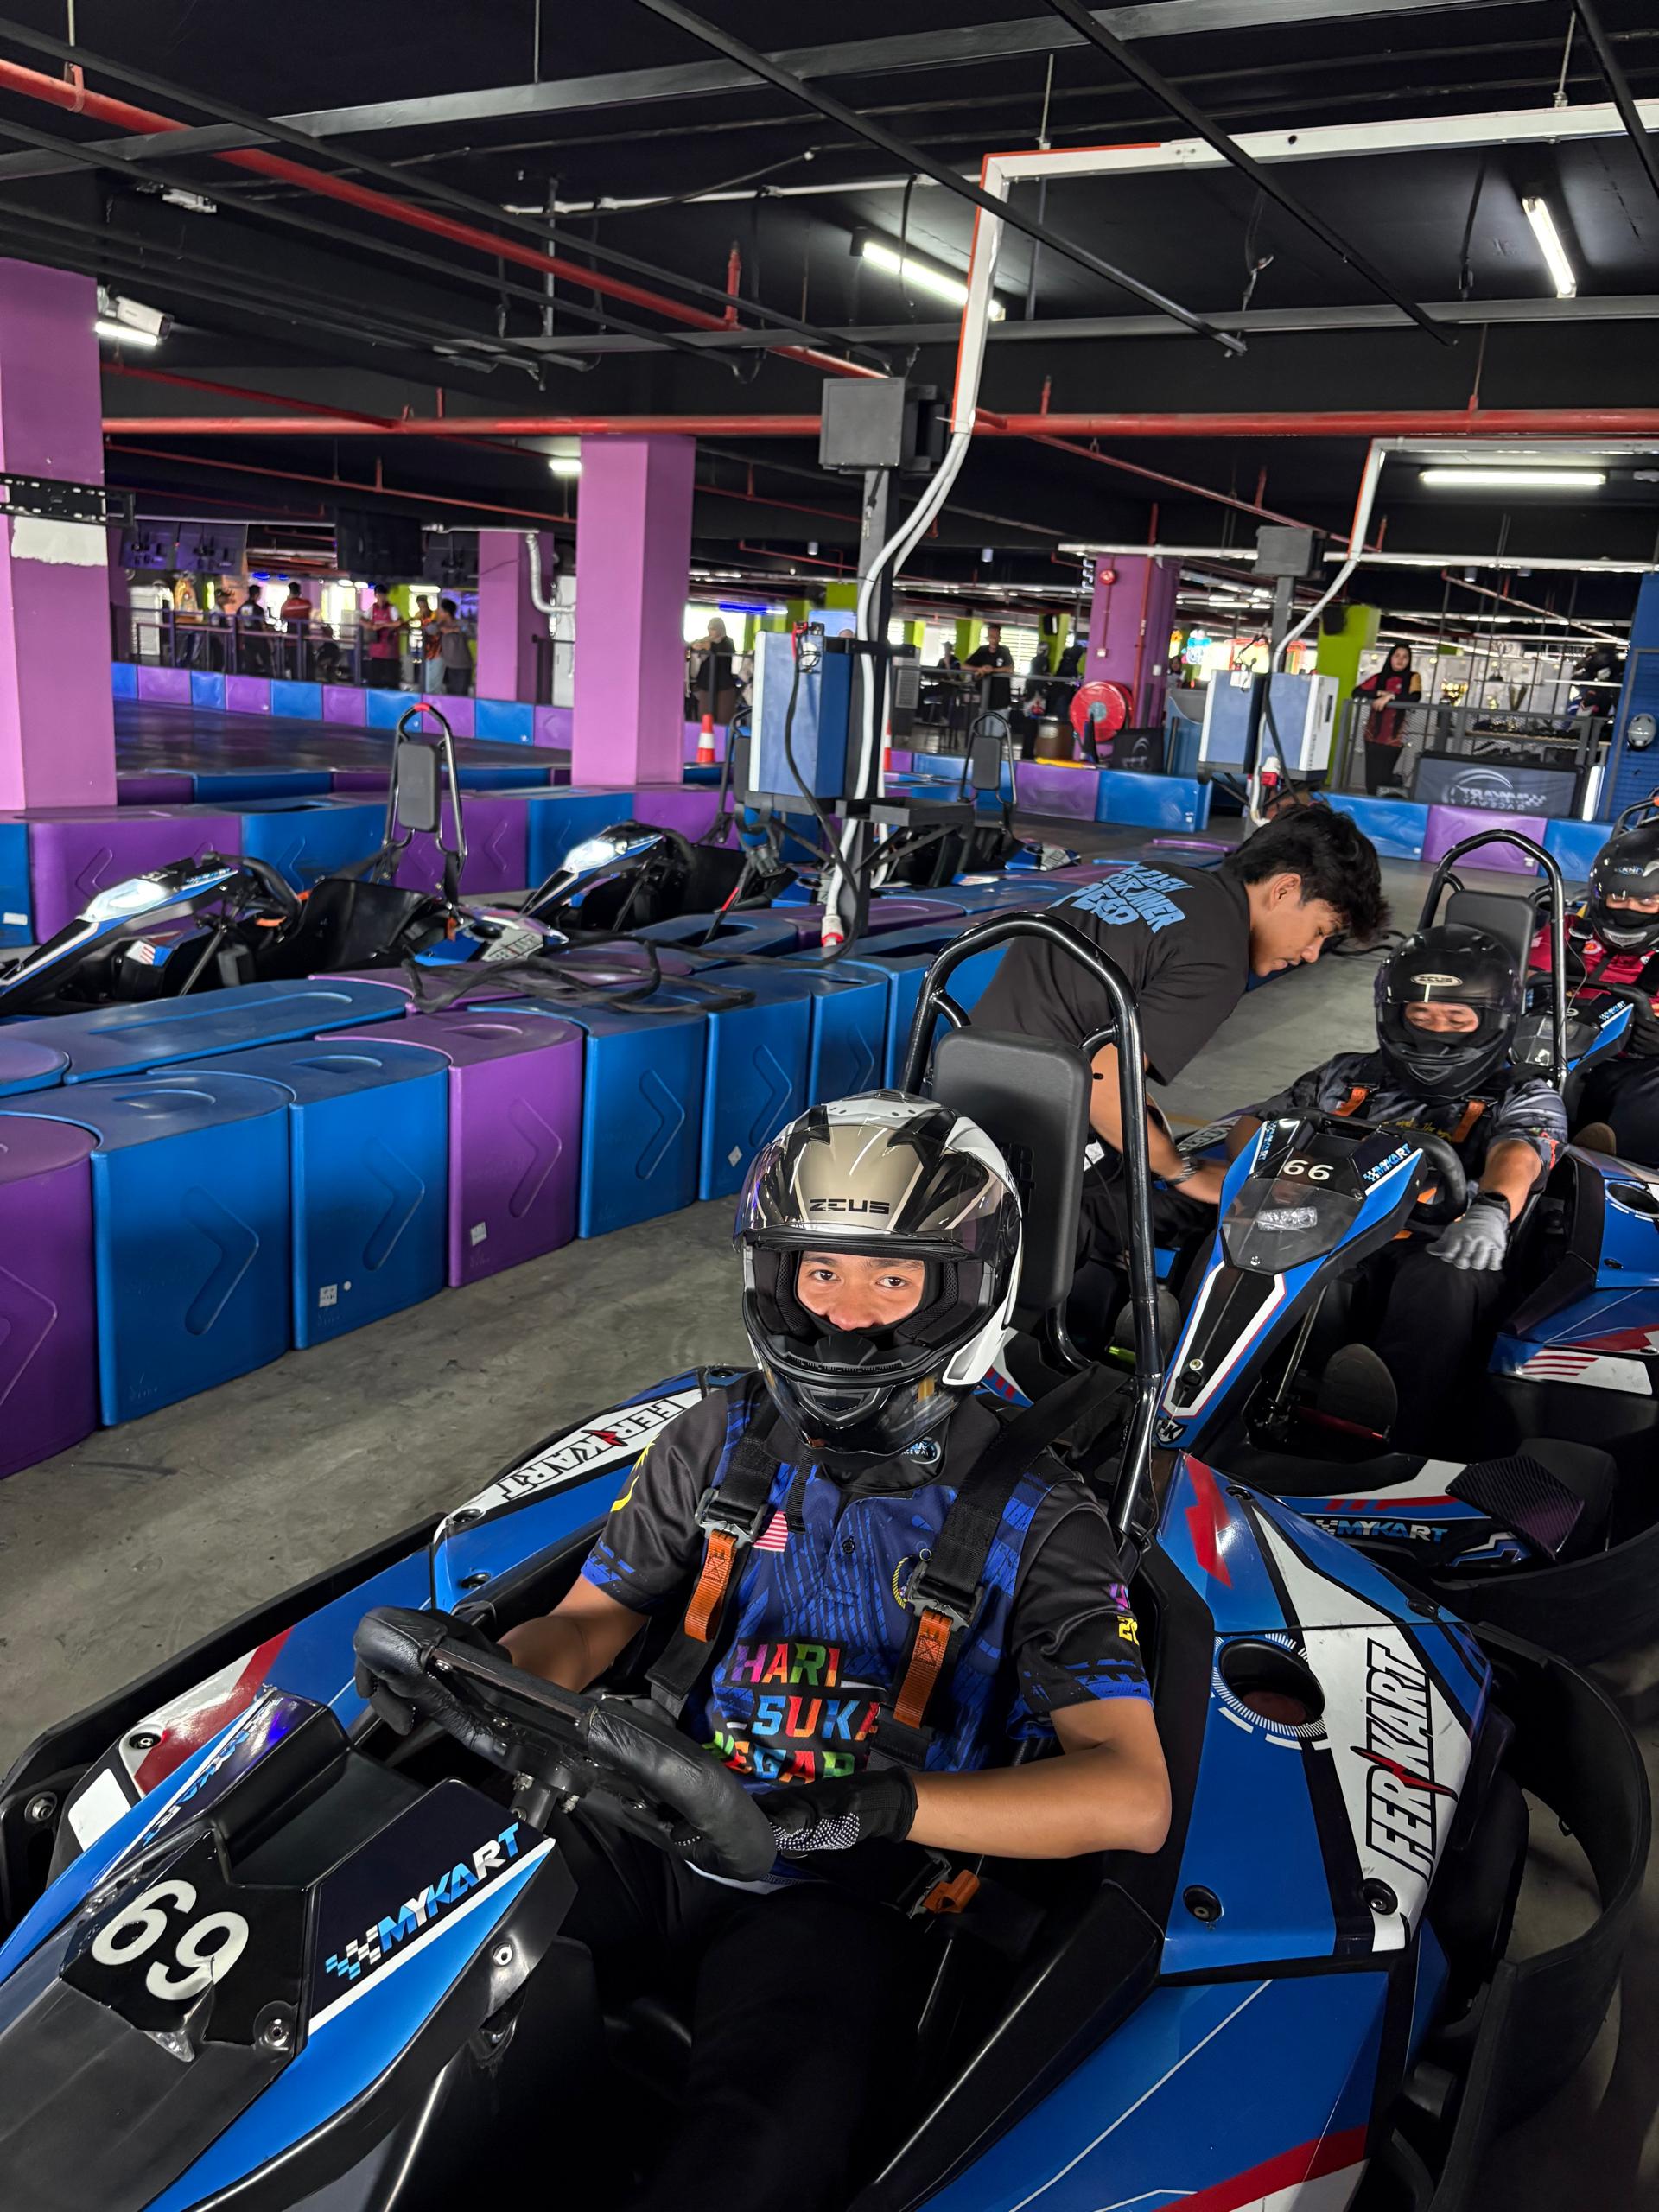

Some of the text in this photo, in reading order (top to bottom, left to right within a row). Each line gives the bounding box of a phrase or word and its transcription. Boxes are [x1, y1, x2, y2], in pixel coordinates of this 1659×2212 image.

[1120, 864, 1195, 893] LEASH
[1047, 881, 1140, 925] PEED
[1122, 887, 1185, 934] INNER
[1283, 1160, 1334, 1181] 66
[1375, 1142, 1413, 1177] MYKART
[810, 1198, 890, 1215] ZEUS
[1338, 1519, 1449, 1543] MYKART
[731, 1643, 841, 1688] HARI
[378, 1821, 519, 1953] MYKART
[91, 1878, 250, 2001] 69
